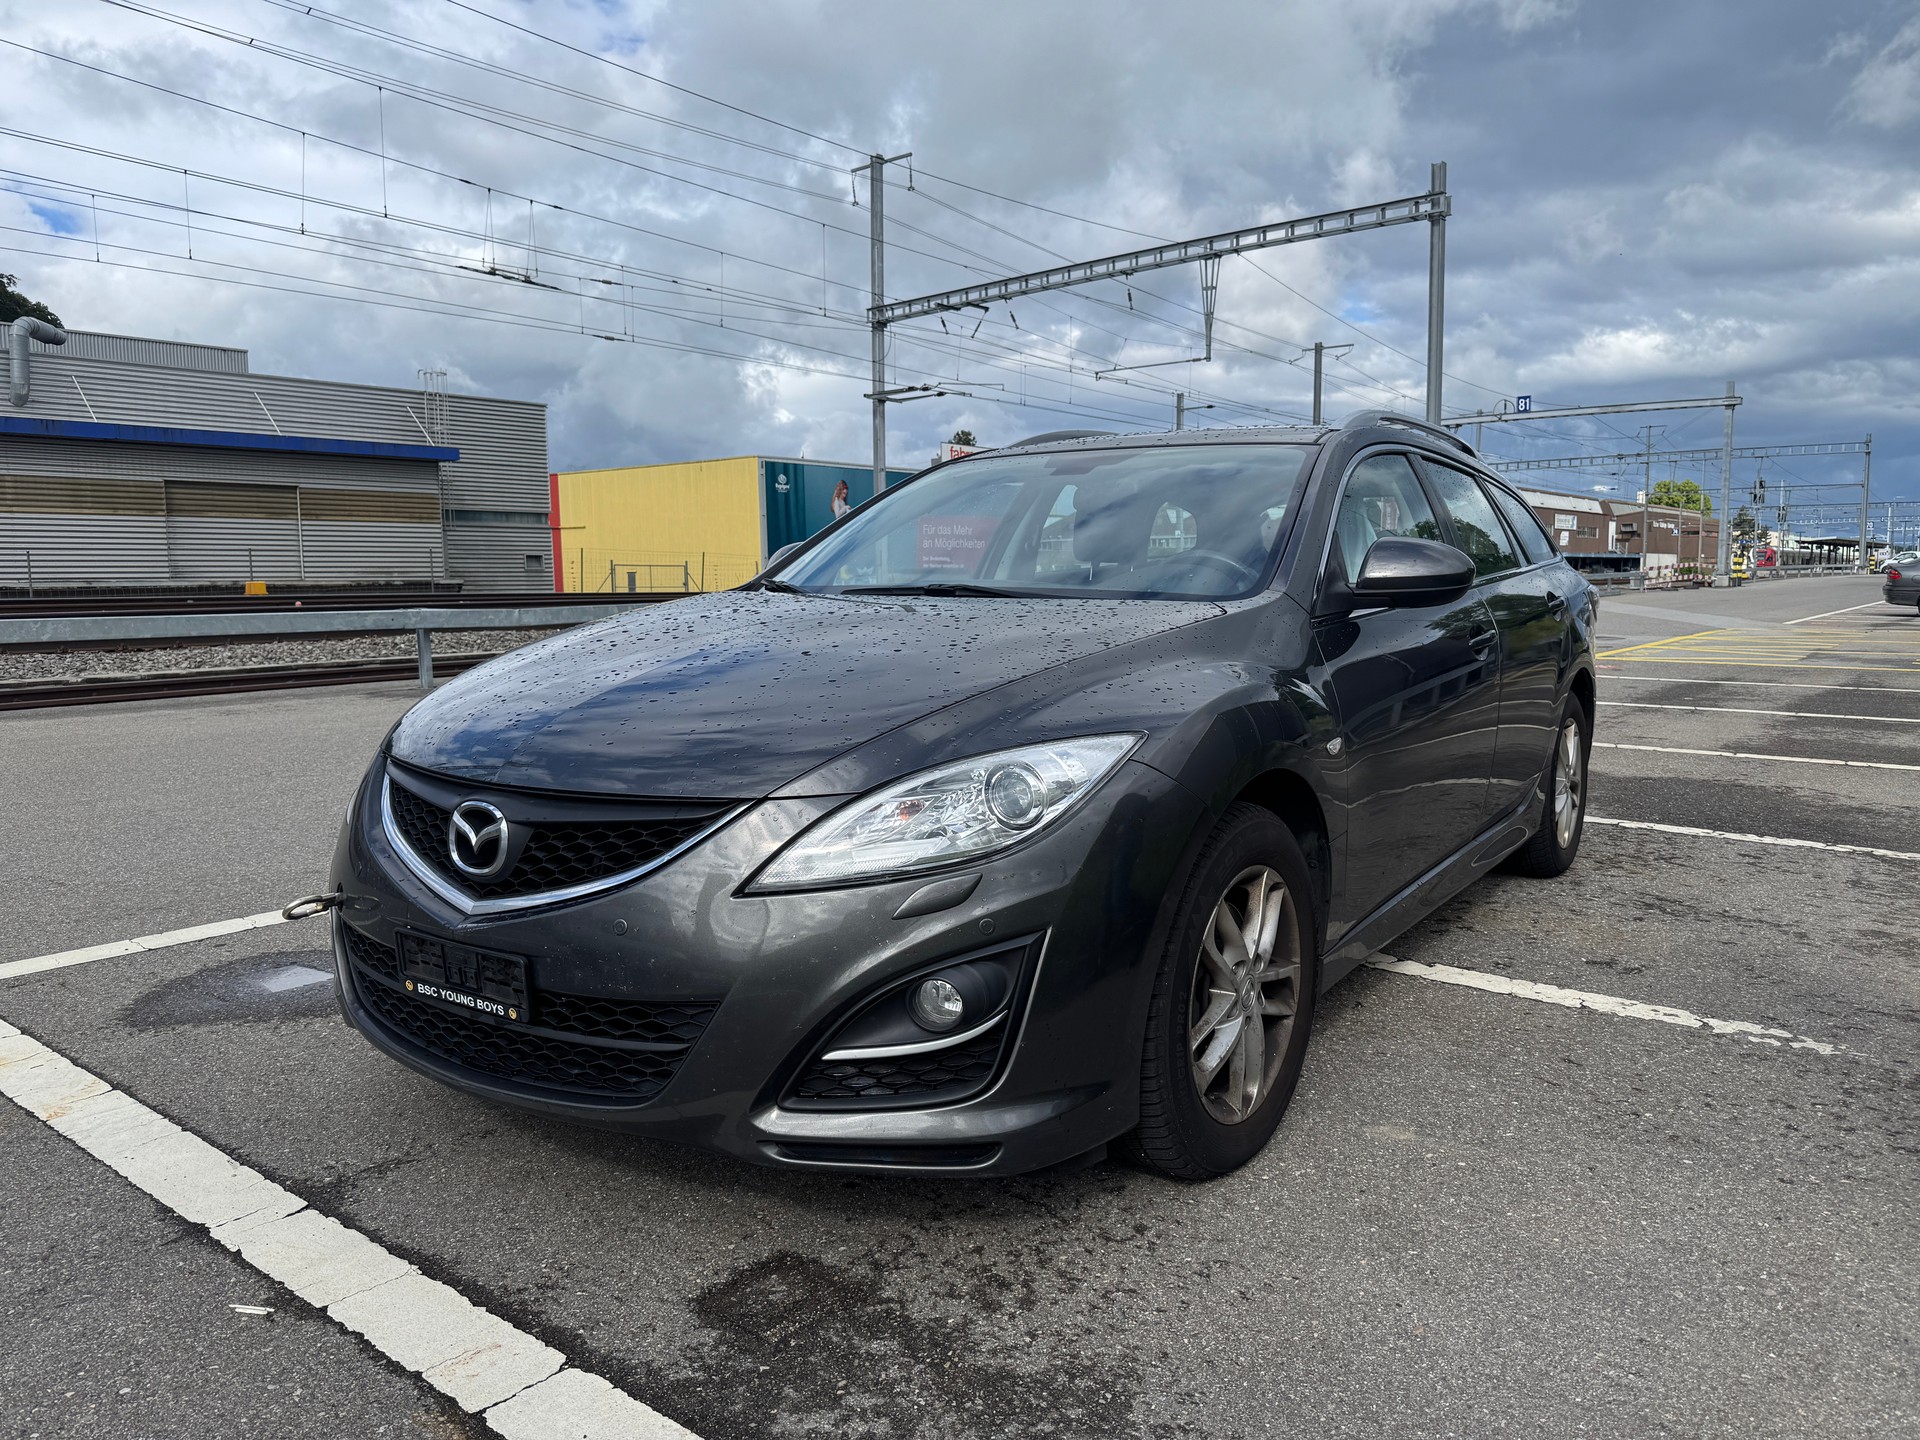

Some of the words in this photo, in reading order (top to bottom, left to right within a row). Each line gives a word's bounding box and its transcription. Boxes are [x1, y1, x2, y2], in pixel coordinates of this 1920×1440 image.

[1518, 397, 1530, 411] 81
[923, 524, 937, 535] Für
[937, 525, 952, 535] das
[953, 525, 974, 536] Mehr
[922, 539, 933, 548] an
[934, 538, 986, 550] Möglichkeiten
[417, 983, 438, 997] BSC
[439, 988, 475, 1007] YOUNG
[476, 999, 505, 1015] BOYS
[1179, 991, 1188, 1000] 2
[1176, 1005, 1186, 1034] PRO
